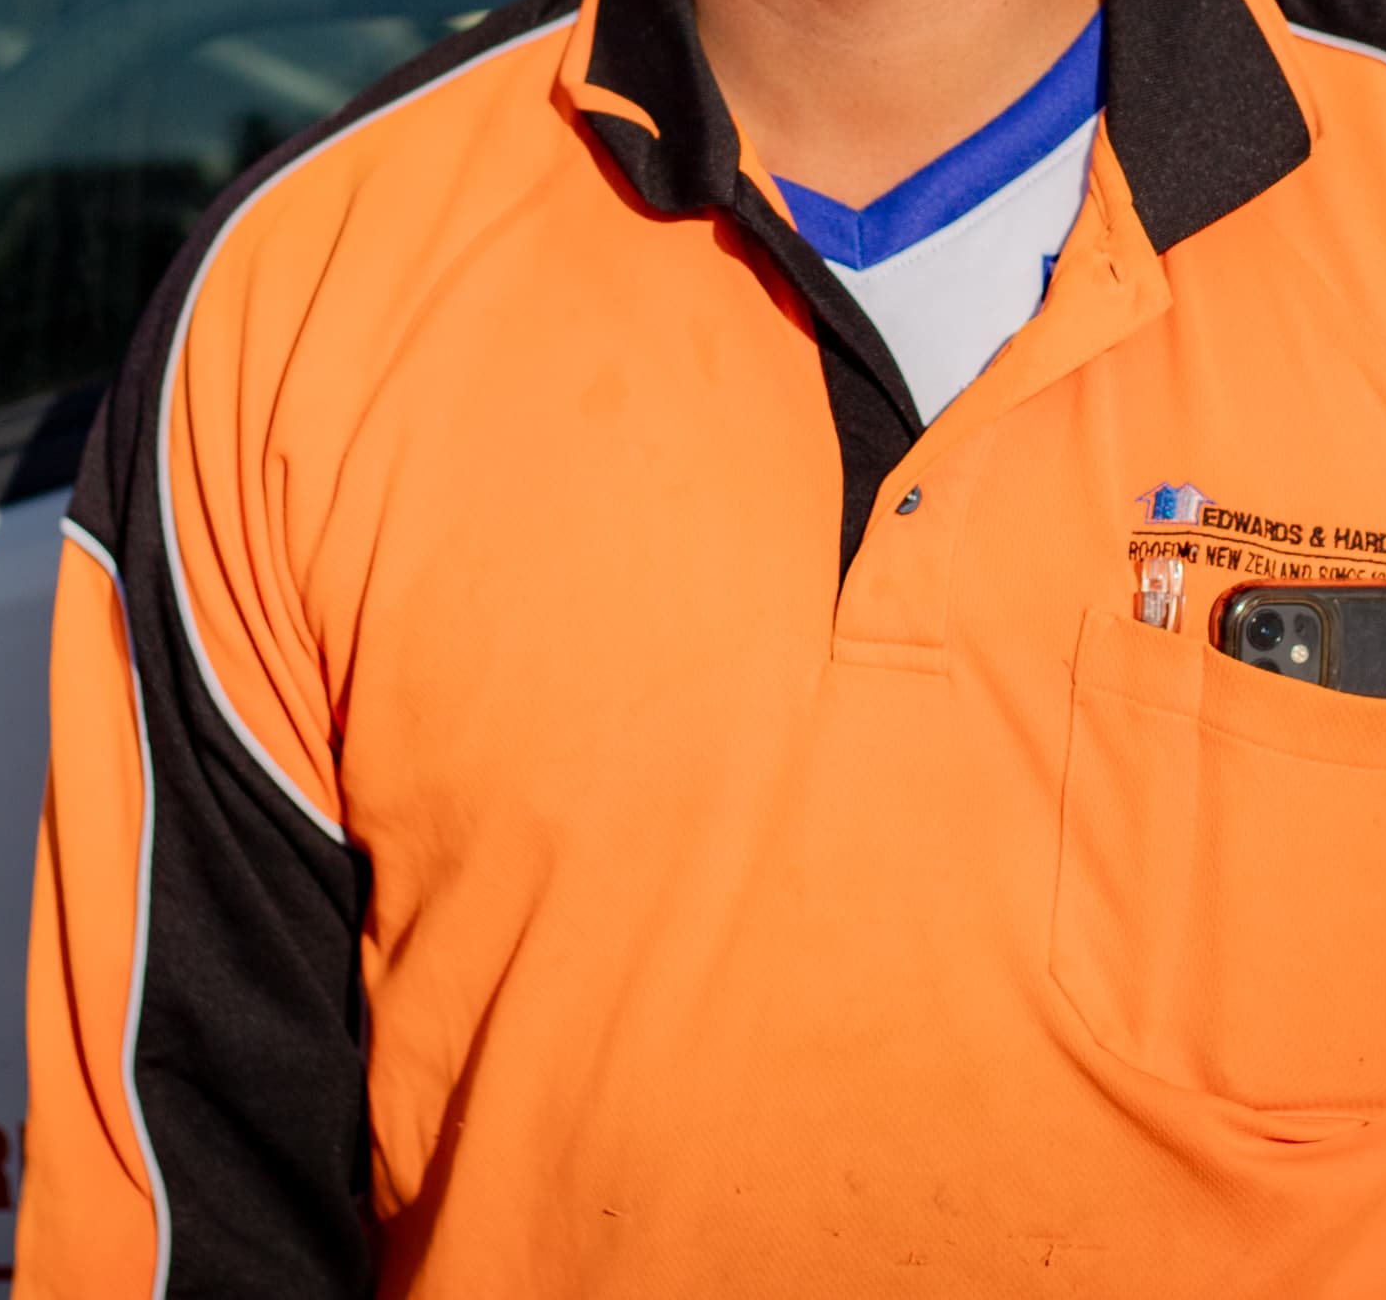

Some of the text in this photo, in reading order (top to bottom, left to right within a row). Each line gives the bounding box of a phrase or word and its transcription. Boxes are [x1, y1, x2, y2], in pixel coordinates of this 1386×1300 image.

[1202, 506, 1303, 546] EDWARDS
[1309, 525, 1326, 549] &
[1206, 545, 1242, 571] NEW
[1244, 551, 1313, 580] ZEALAND
